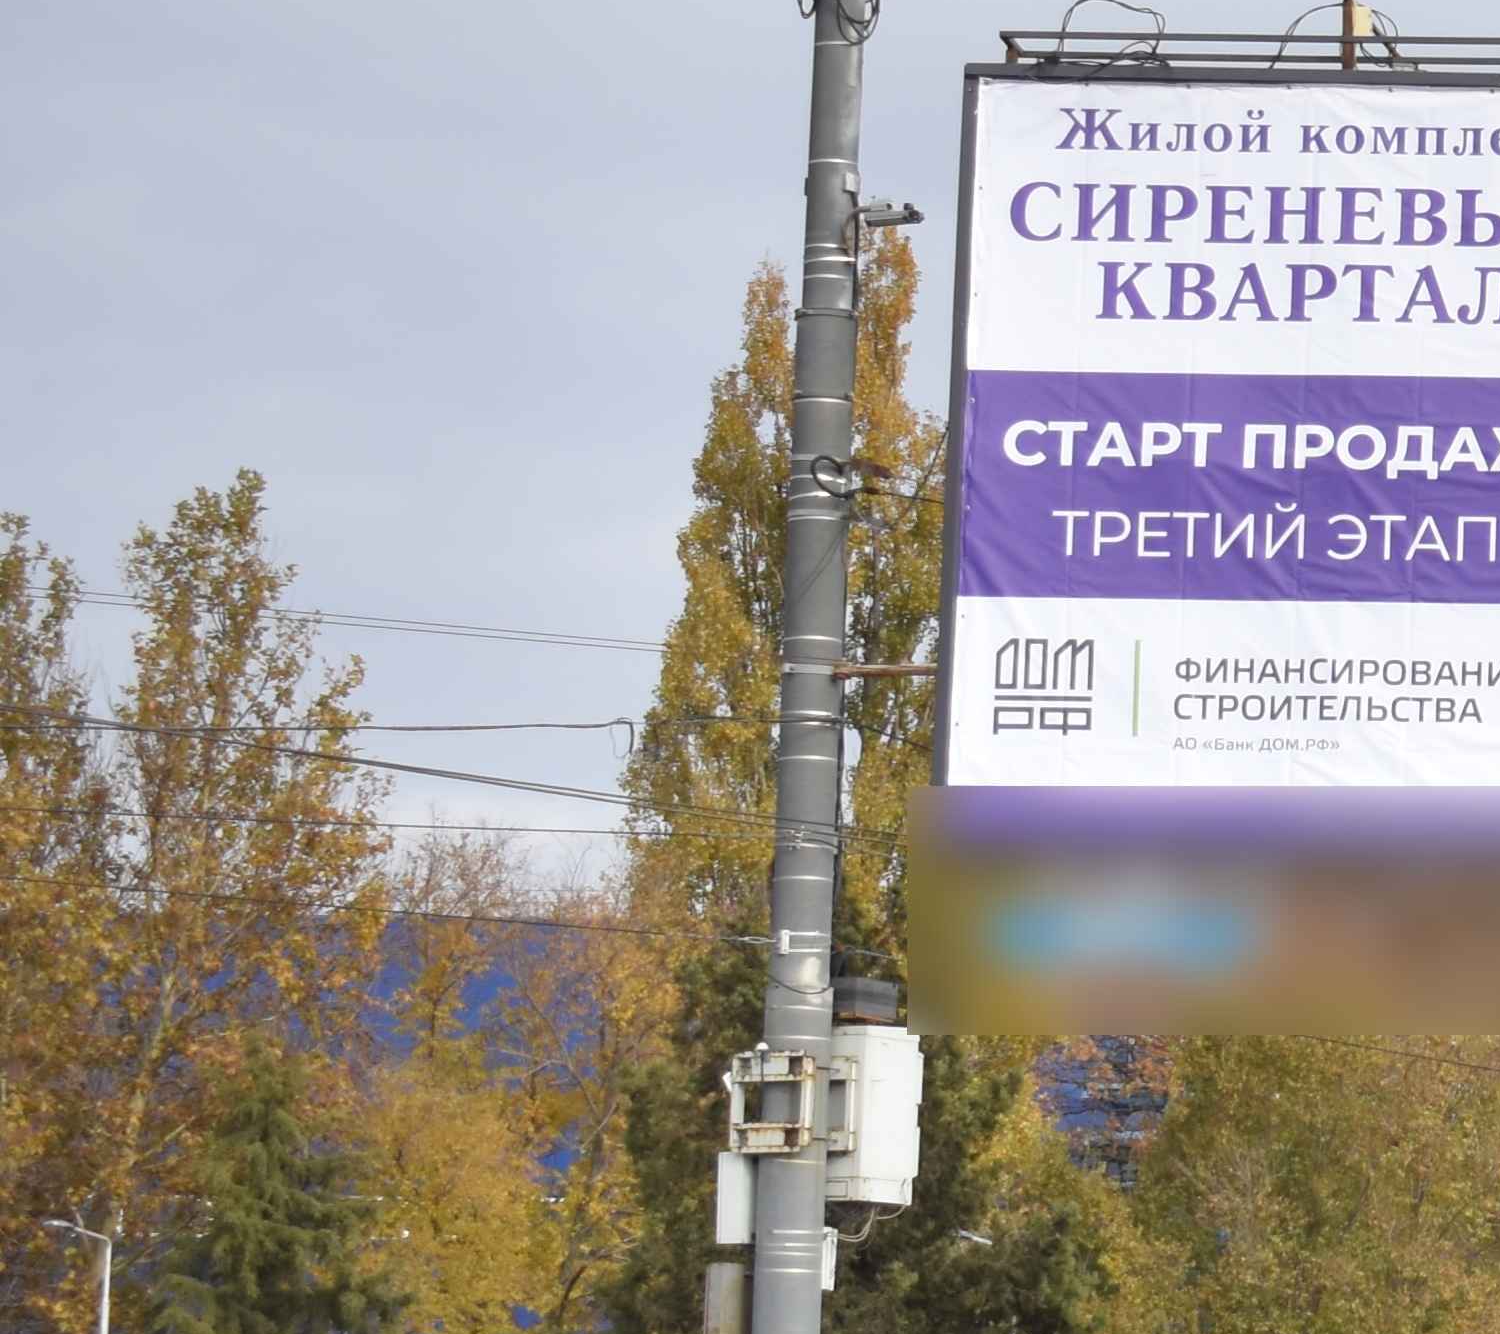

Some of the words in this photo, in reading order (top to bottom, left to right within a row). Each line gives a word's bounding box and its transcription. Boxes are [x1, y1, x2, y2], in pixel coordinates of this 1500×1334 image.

[1056, 108, 1272, 153] Жилой
[1002, 420, 1223, 468] СТАРТ
[1051, 502, 1305, 560] ТРЕТИЙ
[1326, 513, 1498, 562] ЭТАП
[994, 637, 1095, 691] ДОМ
[992, 705, 1093, 736] РФ
[1173, 693, 1484, 724] СТРОИТЕЛЬСТВА
[1172, 736, 1198, 751] АО
